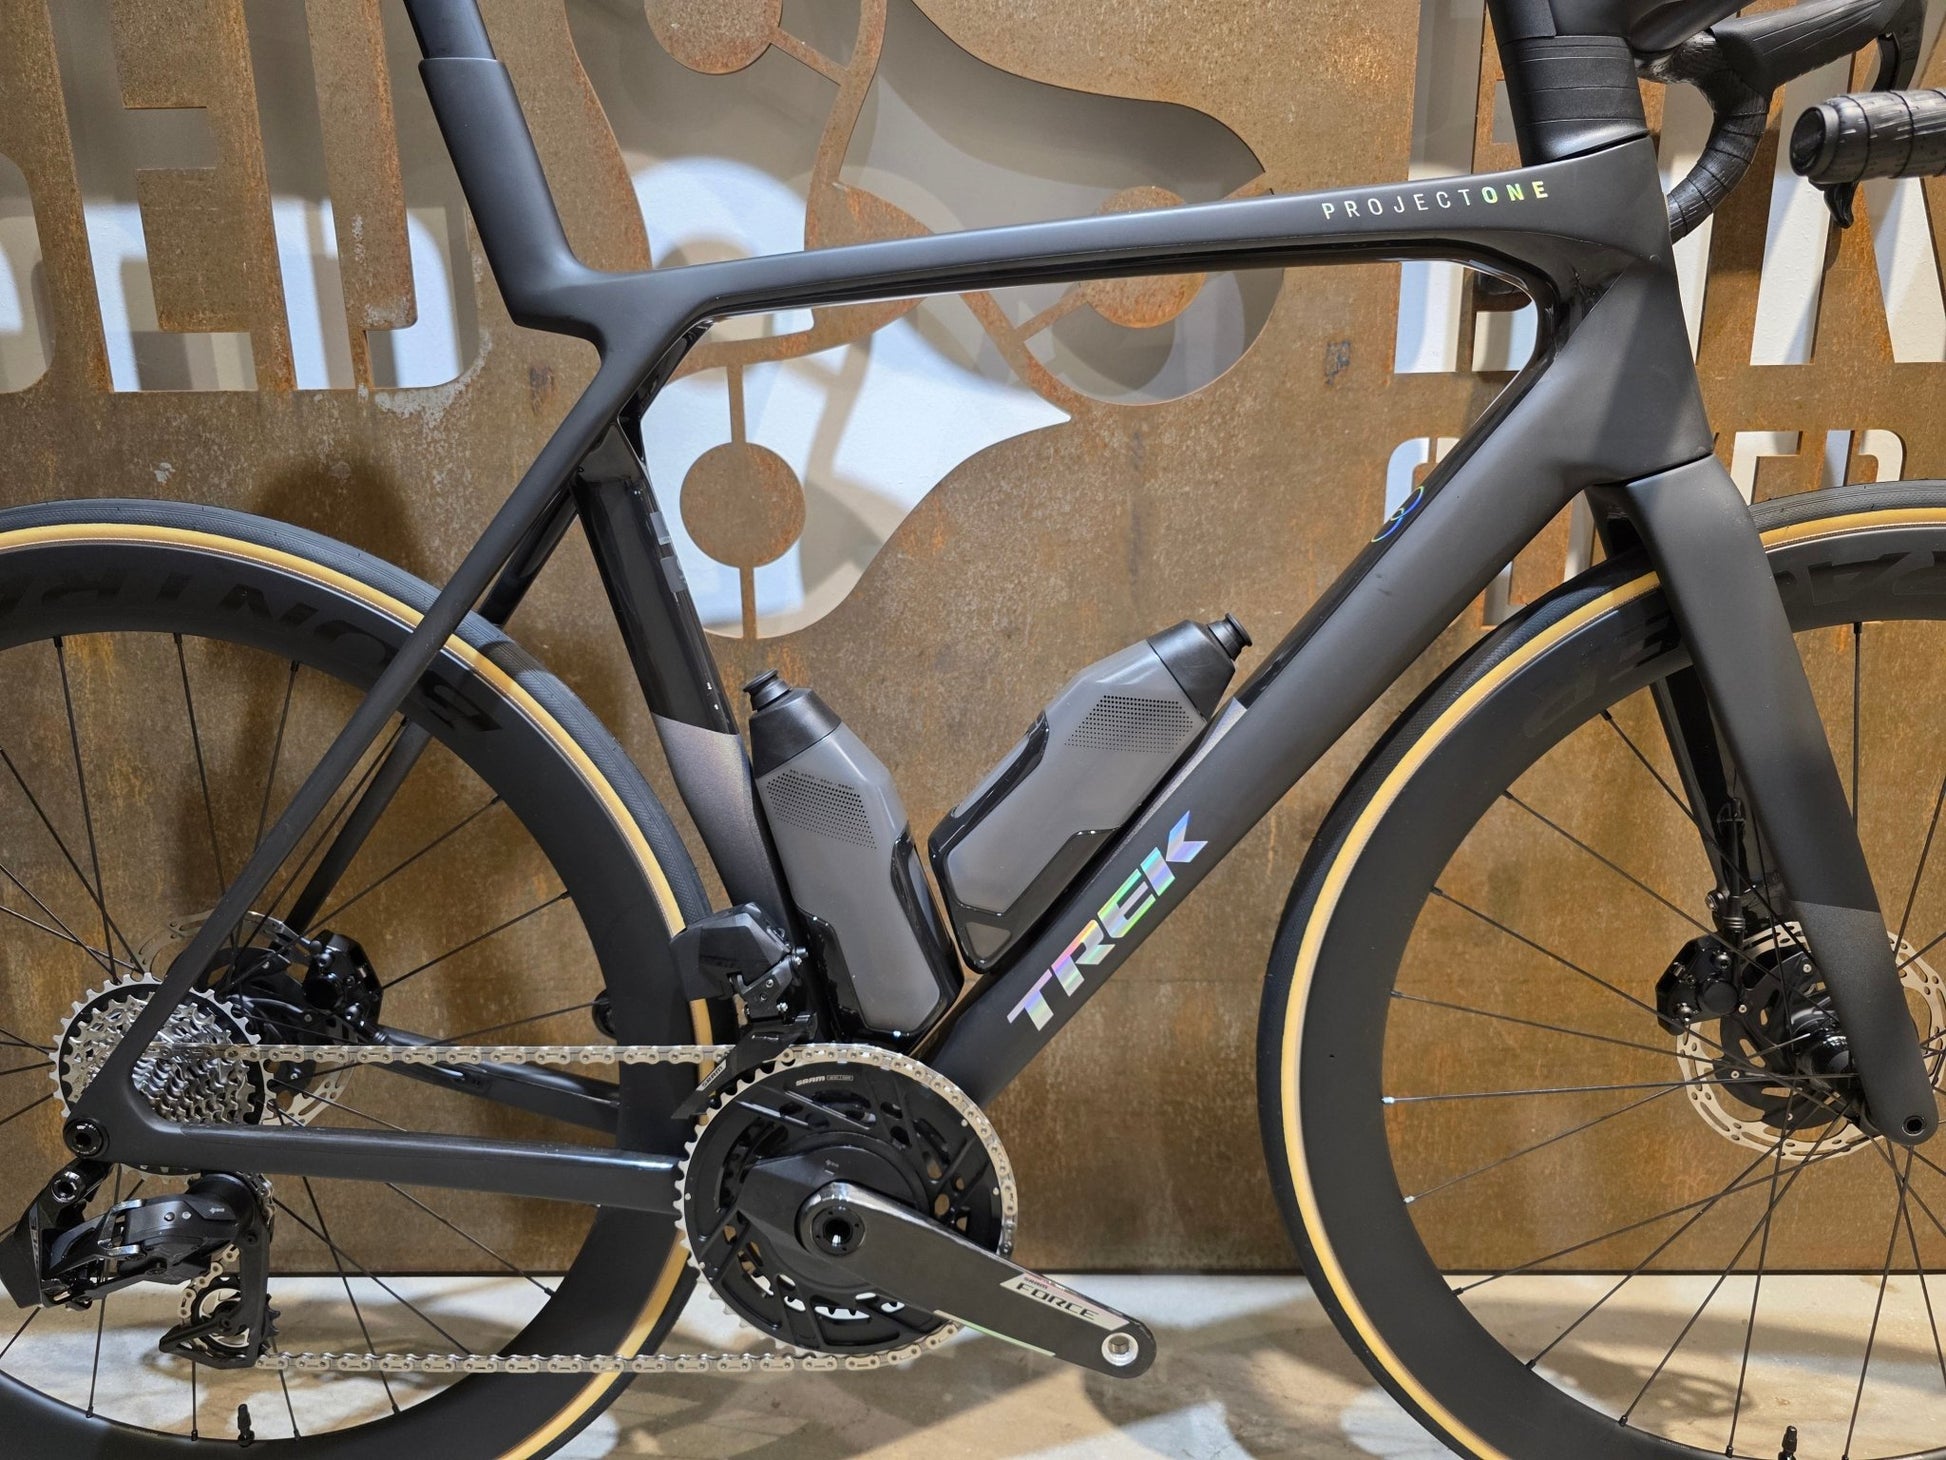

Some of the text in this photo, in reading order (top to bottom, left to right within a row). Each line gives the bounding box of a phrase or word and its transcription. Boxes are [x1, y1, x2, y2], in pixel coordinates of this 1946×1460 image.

[1006, 809, 1209, 1032] TREK
[795, 1075, 825, 1086] SRAM
[1016, 1282, 1099, 1321] FORCE
